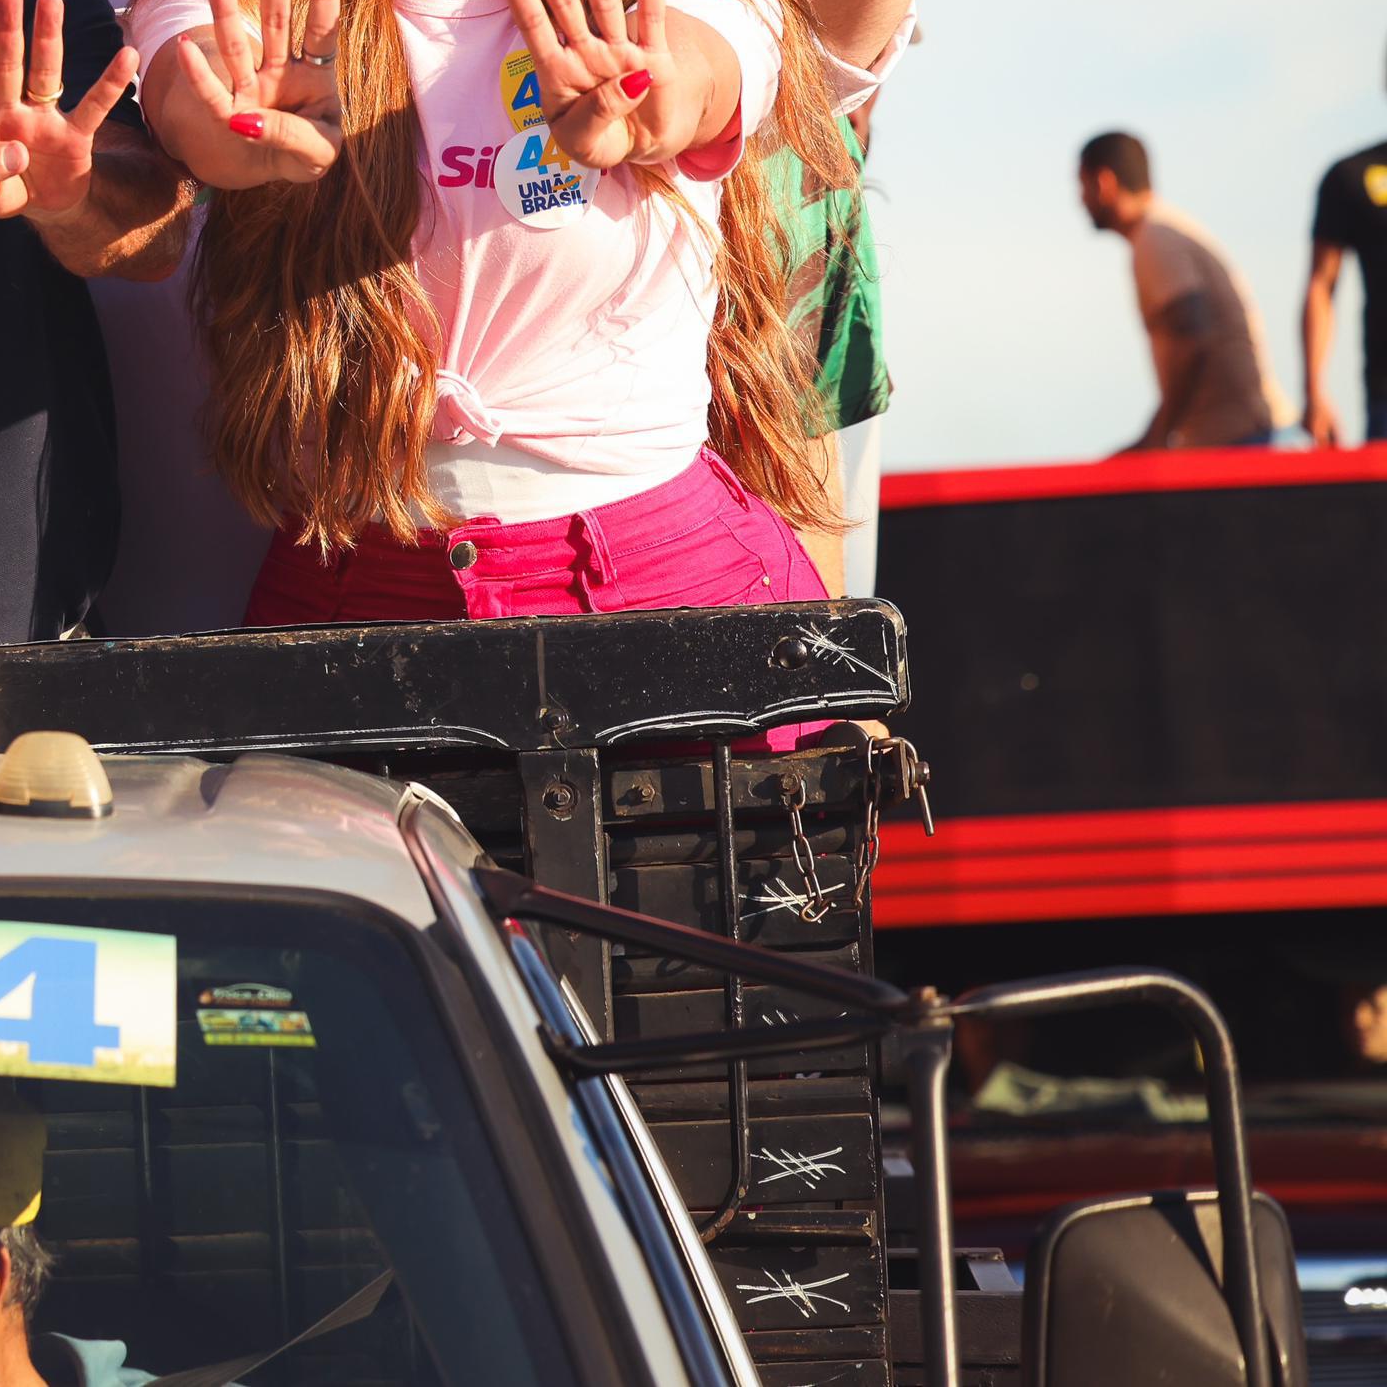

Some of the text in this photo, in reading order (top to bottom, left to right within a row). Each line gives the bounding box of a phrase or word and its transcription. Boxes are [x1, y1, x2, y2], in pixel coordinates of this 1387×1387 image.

[438, 144, 504, 189] Sil
[518, 172, 582, 199] UNIÃO
[521, 189, 588, 215] BRASIL
